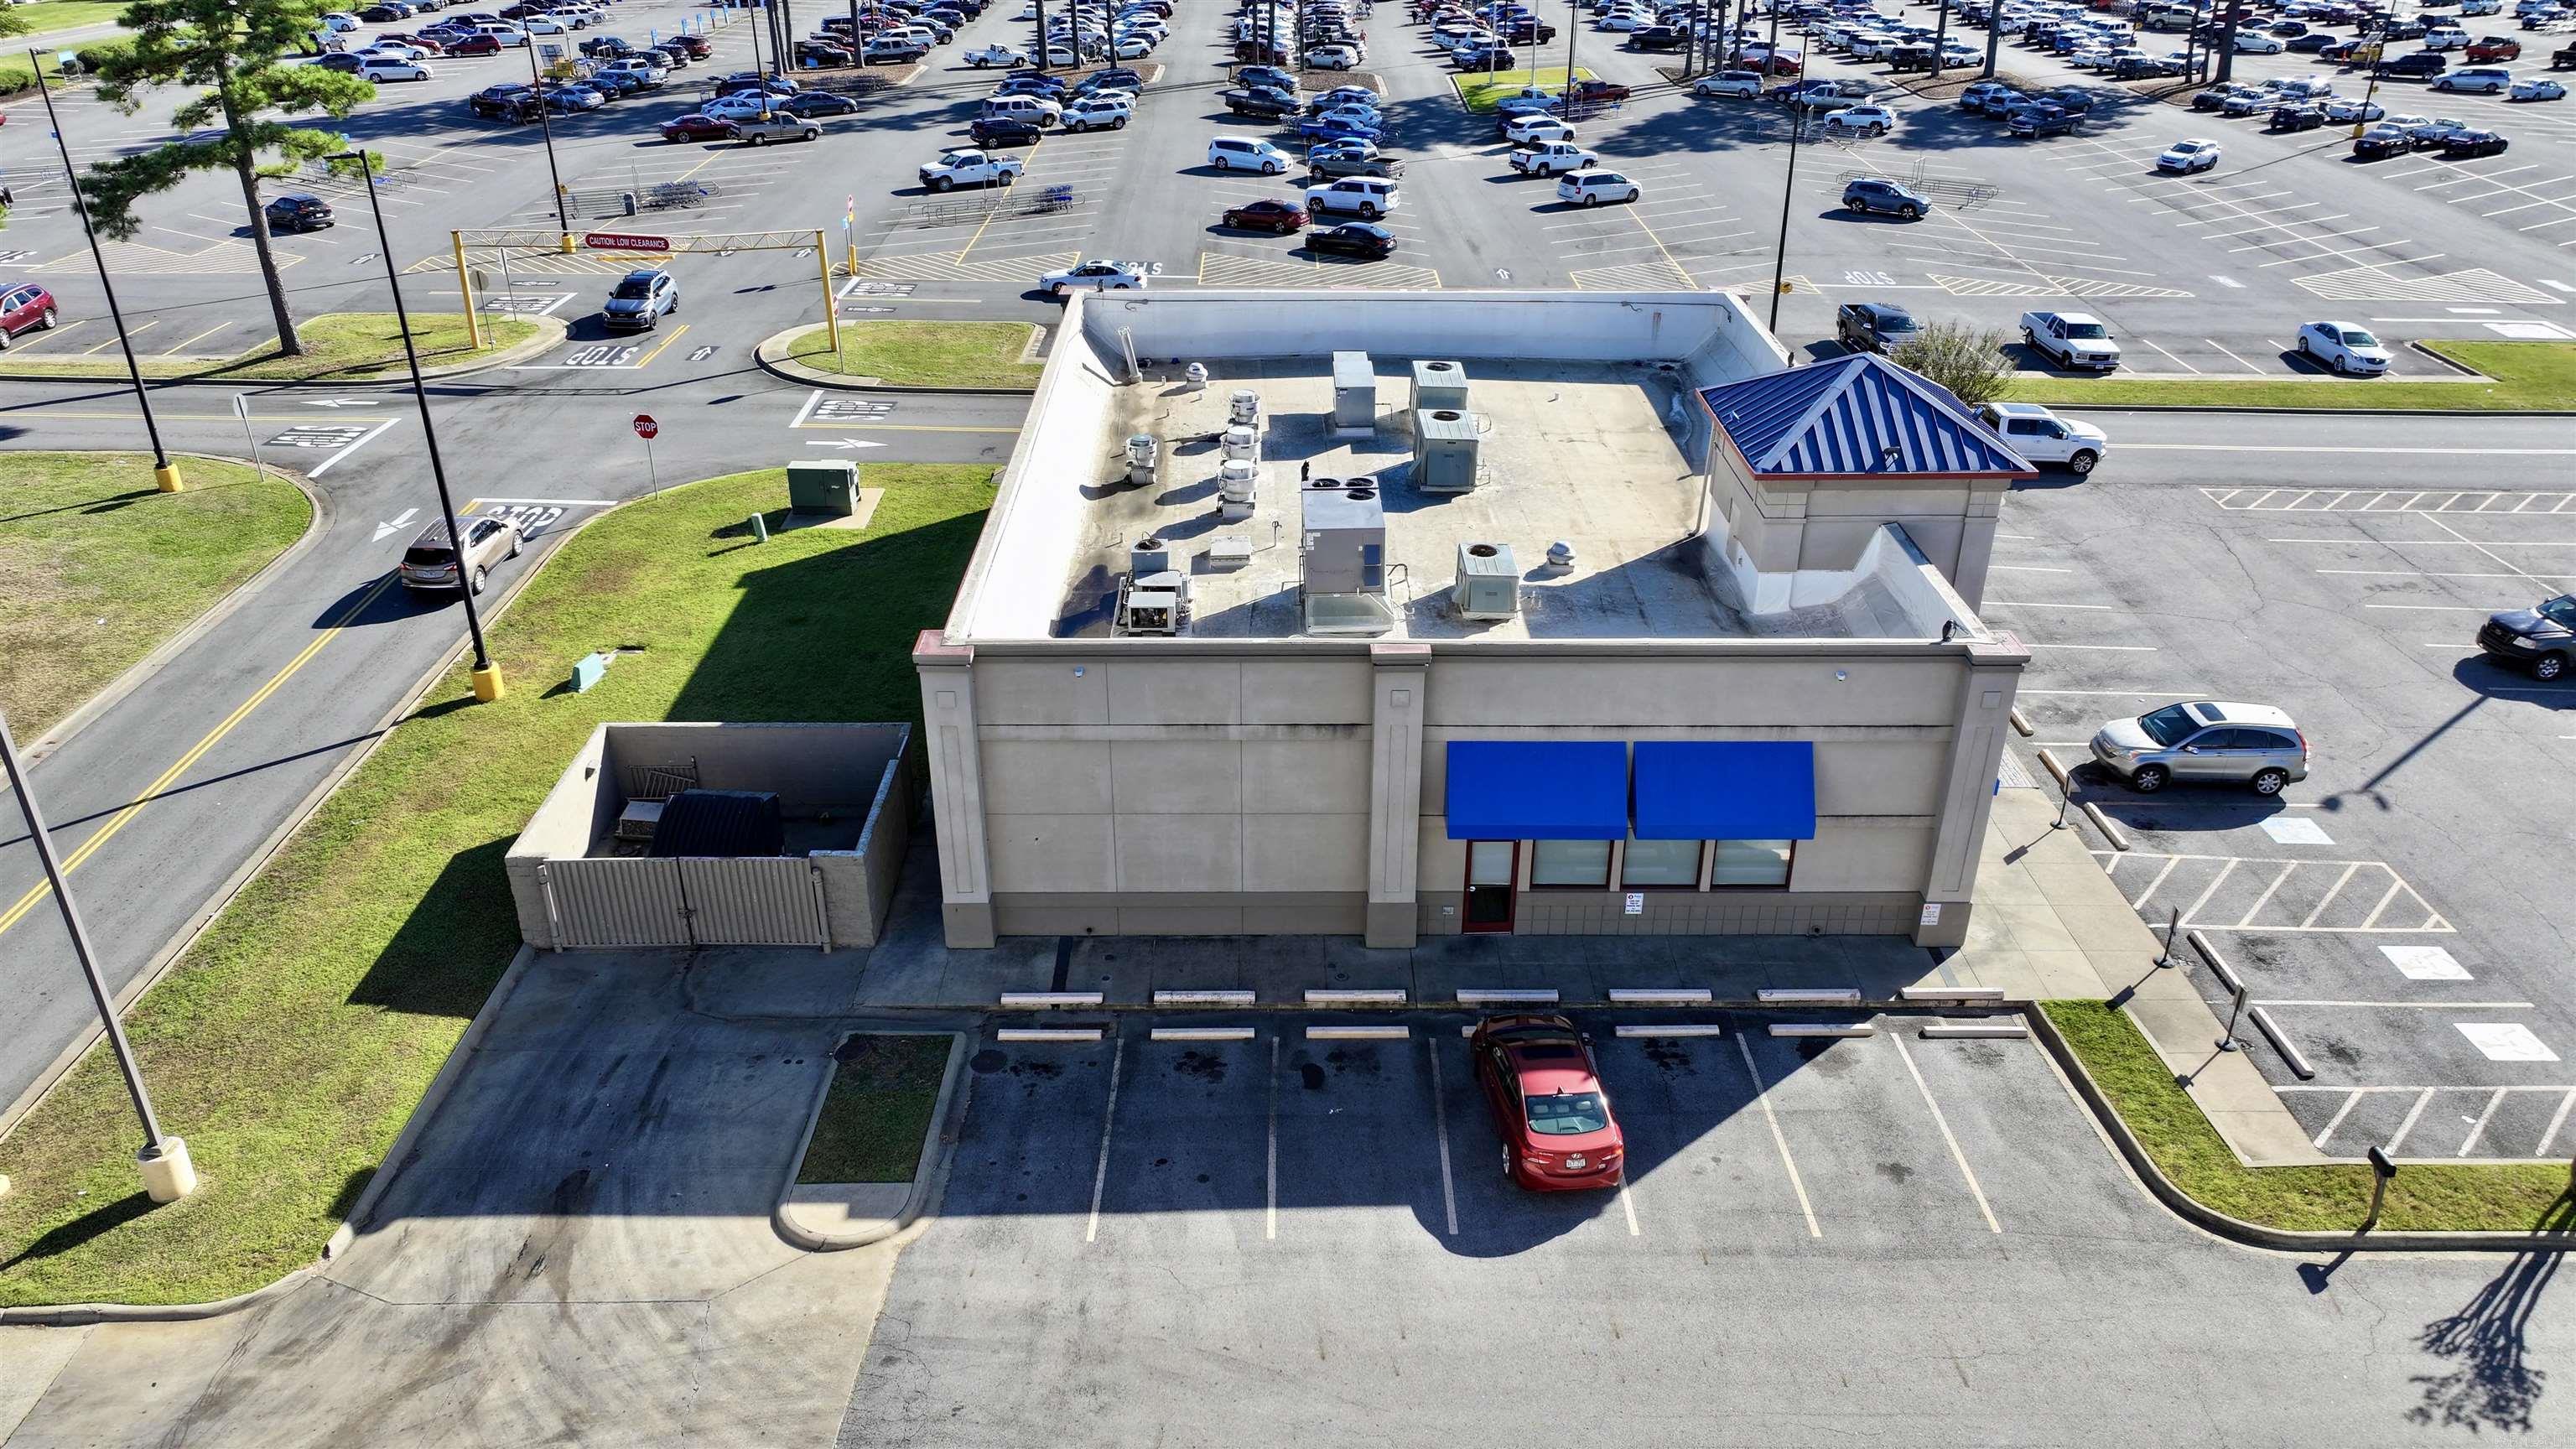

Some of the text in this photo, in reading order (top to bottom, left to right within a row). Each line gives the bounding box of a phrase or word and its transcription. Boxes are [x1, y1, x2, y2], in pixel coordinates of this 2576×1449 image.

[589, 236, 616, 246] CAUTION:
[631, 239, 666, 248] CLEARANCE
[1844, 270, 1897, 285] STOP
[851, 282, 917, 296] STOP
[486, 296, 557, 311] STOP
[565, 345, 639, 365] STOP
[813, 400, 893, 421] STOP
[635, 422, 657, 432] STOP
[270, 425, 369, 448] STOP
